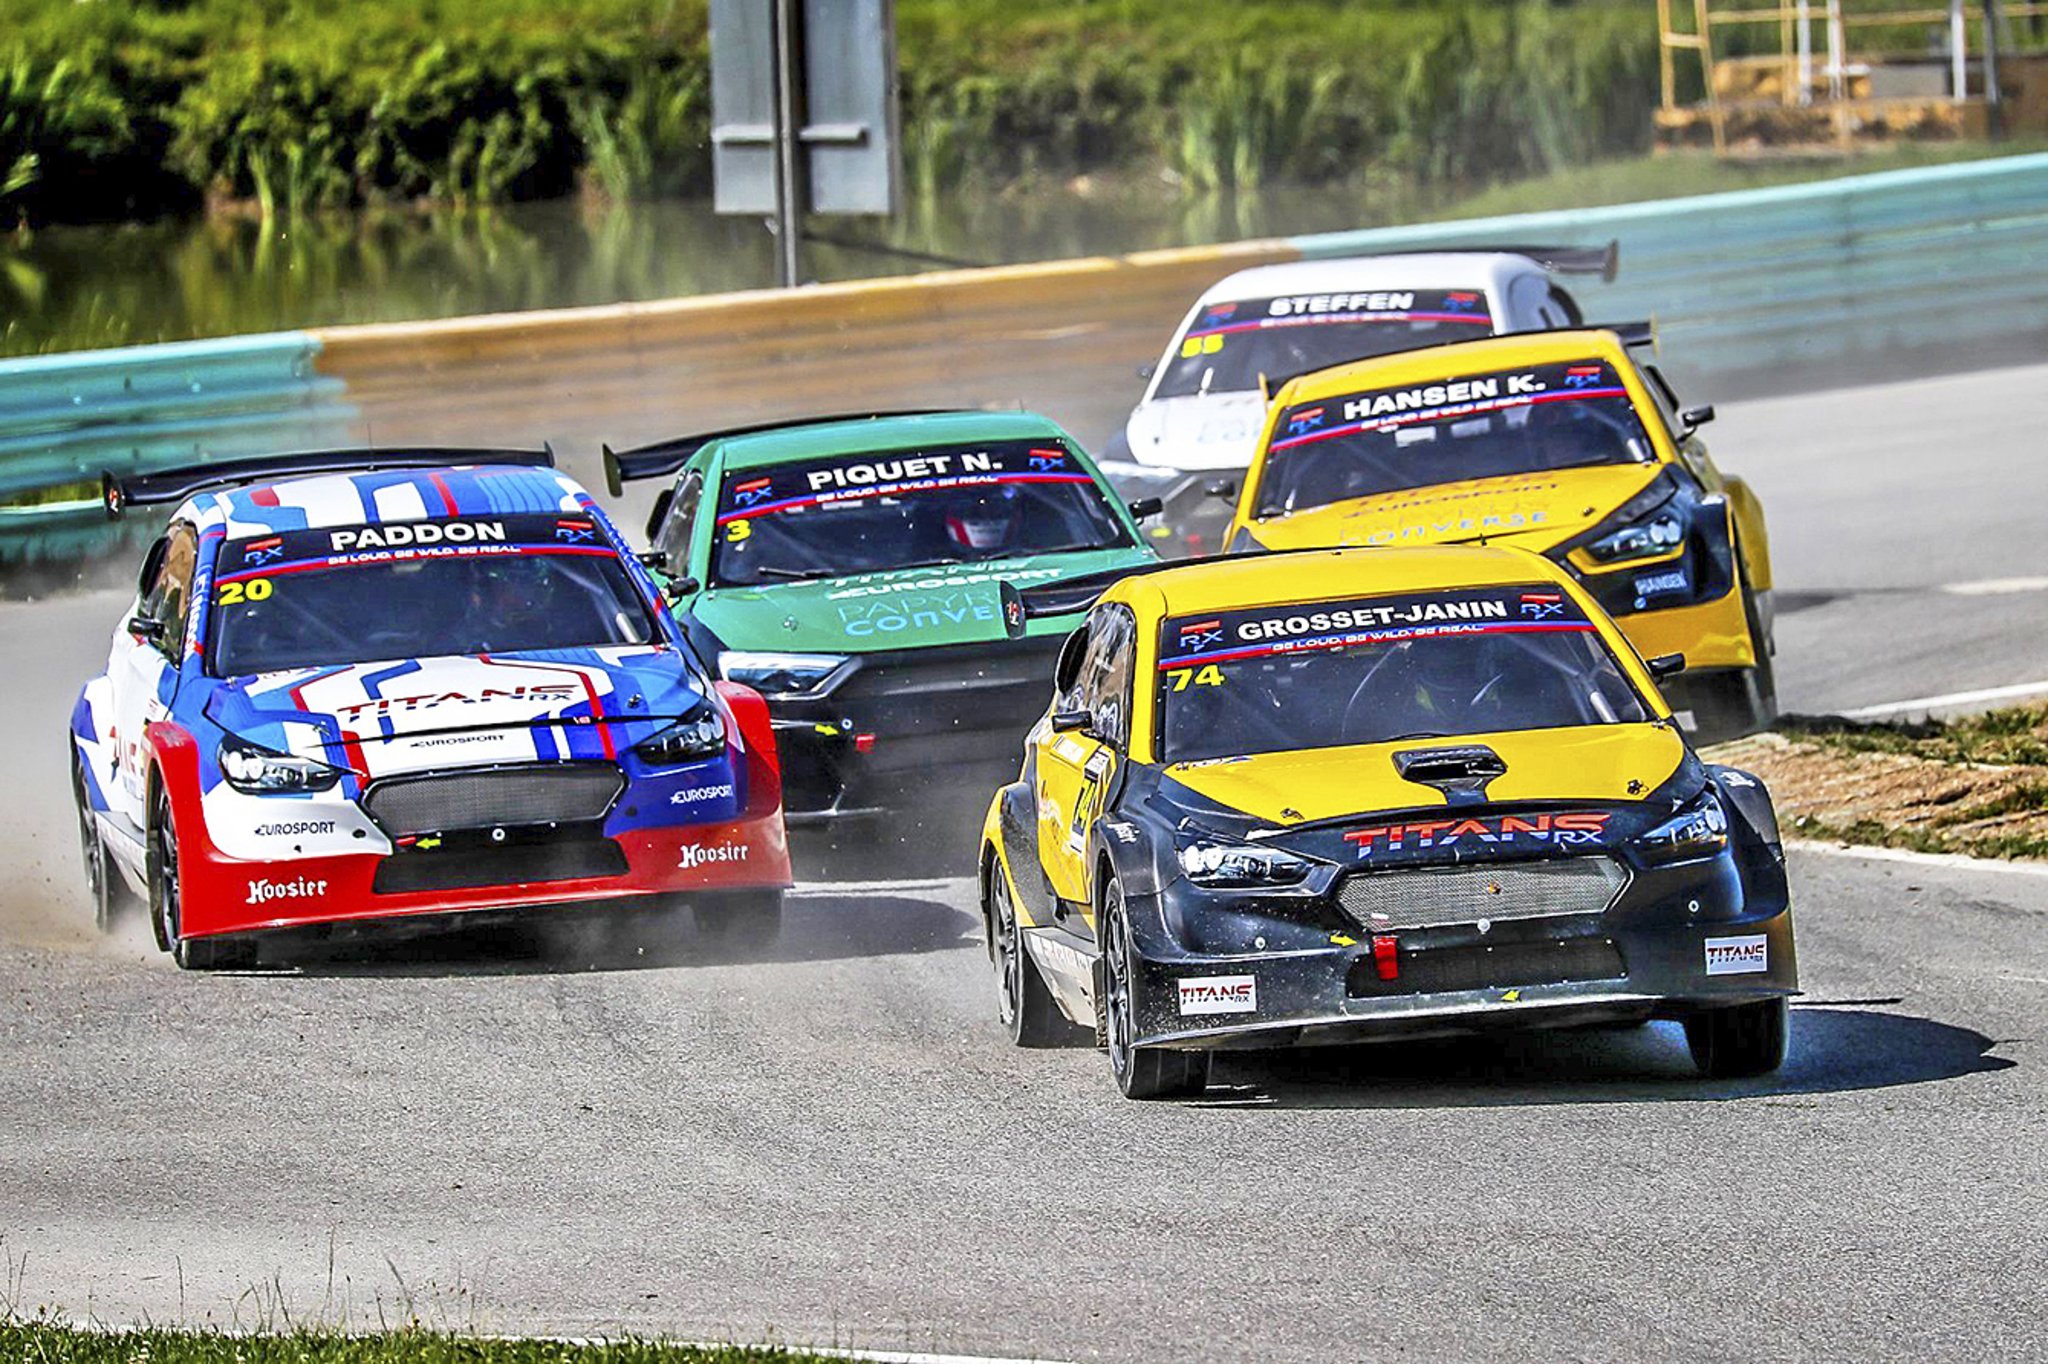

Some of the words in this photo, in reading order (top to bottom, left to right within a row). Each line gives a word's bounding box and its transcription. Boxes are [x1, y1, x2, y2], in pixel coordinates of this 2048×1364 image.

[1268, 292, 1415, 316] STEFFEN
[1344, 378, 1498, 420] HANSEN
[1507, 374, 1546, 395] K.
[807, 455, 951, 490] PIQUET
[961, 452, 1003, 472] N.
[330, 521, 506, 551] PADDON
[726, 519, 751, 542] 3
[218, 578, 272, 606] 20
[1238, 600, 1507, 640] GROSSET-JANIN
[1166, 664, 1225, 692] 74
[337, 685, 578, 722] TITANS
[529, 693, 571, 702] RX
[410, 735, 505, 749] EUROSPORT
[254, 821, 336, 836] EUROSPORT
[1344, 813, 1612, 860] TITANS
[1553, 831, 1603, 844] RX
[677, 840, 749, 869] Hoosier
[245, 875, 328, 905] Hoosier
[1707, 944, 1765, 965] TITANS
[1180, 984, 1254, 1005] TITANS
